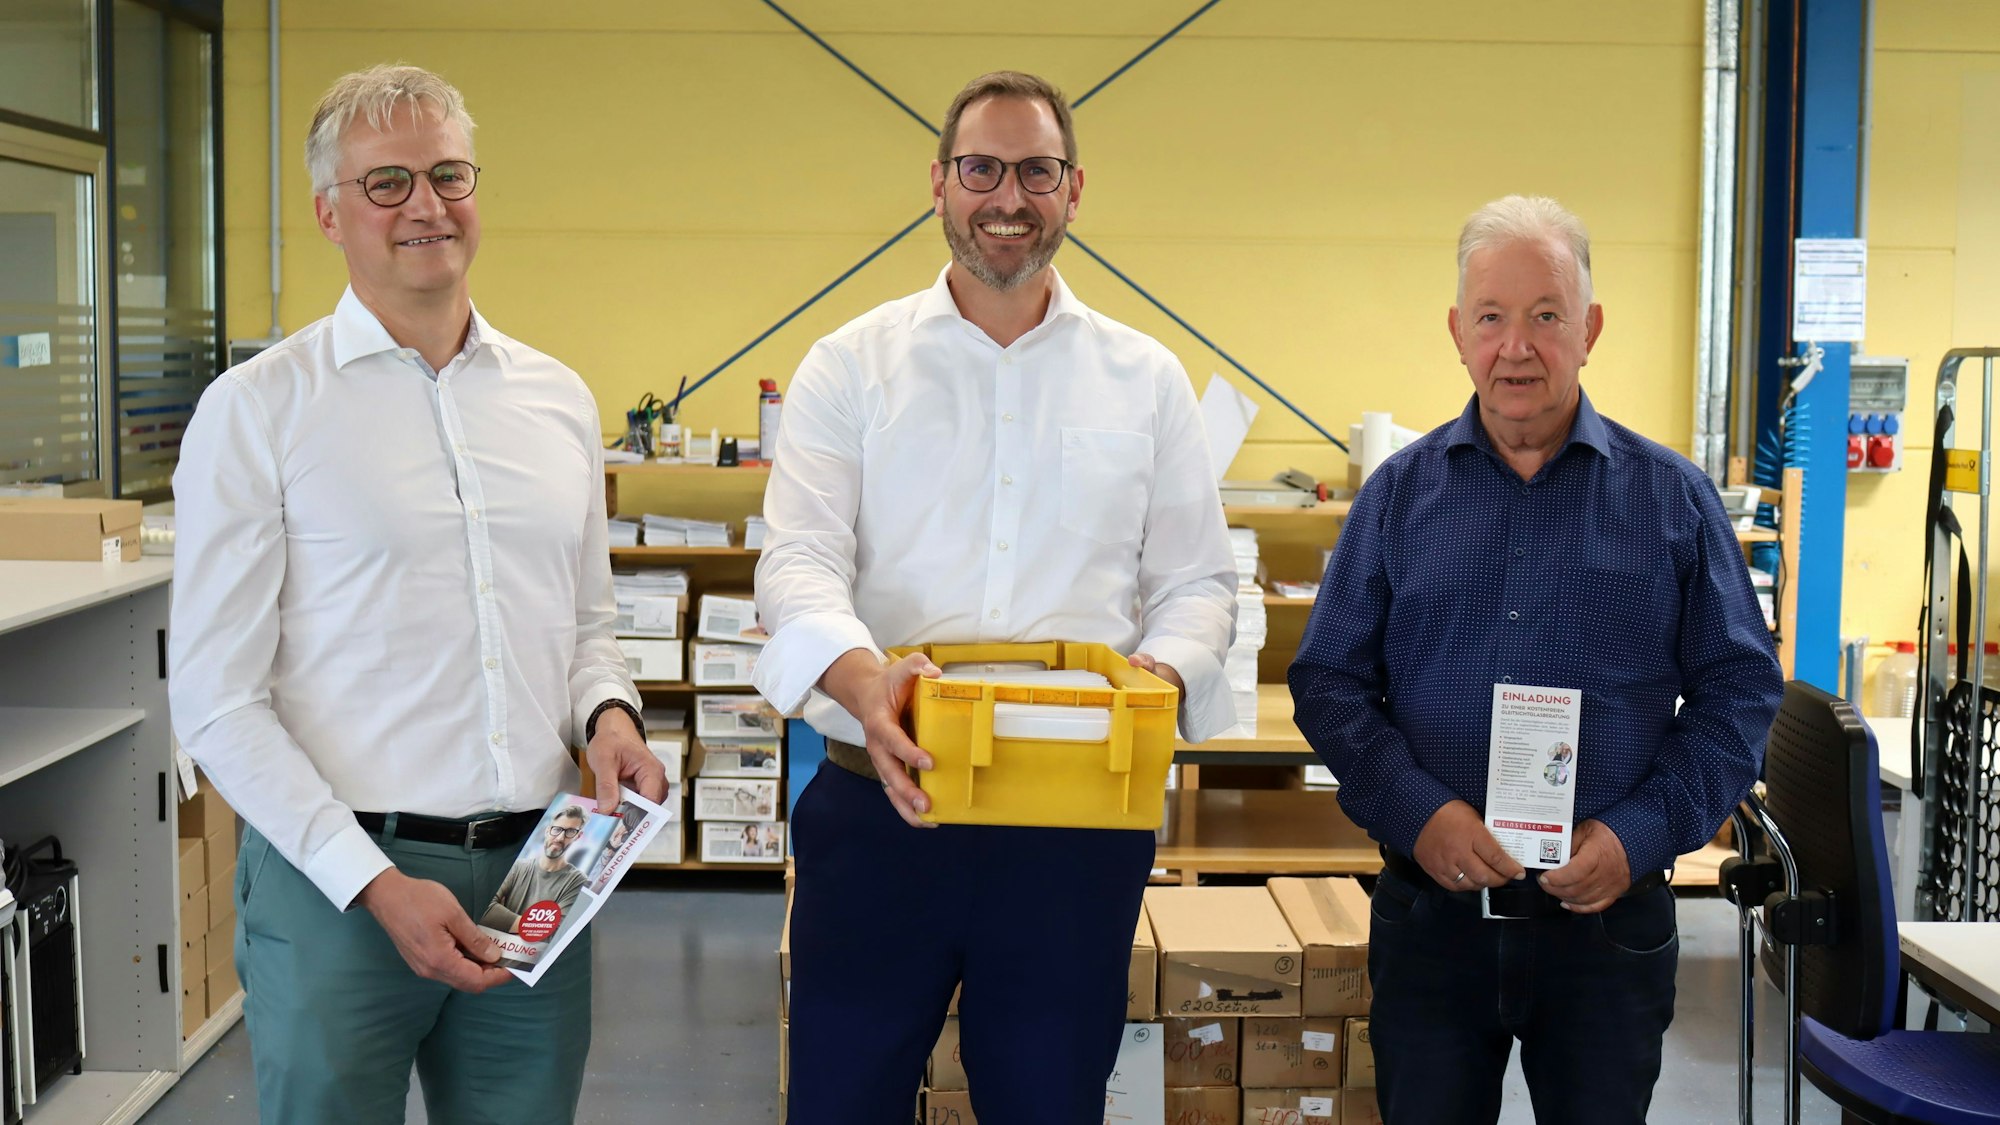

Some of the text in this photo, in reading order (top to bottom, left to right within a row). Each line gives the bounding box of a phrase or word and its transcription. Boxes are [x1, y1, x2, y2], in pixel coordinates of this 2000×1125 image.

[1502, 691, 1572, 705] EINLADUNG
[1501, 710, 1570, 720] GLEITSICHTGLASBERATUNG
[599, 821, 651, 884] KUNDENINFO
[526, 908, 558, 922] 50%
[1278, 958, 1290, 971] 3
[1166, 1040, 1205, 1063] 00
[1215, 1067, 1233, 1081] 10
